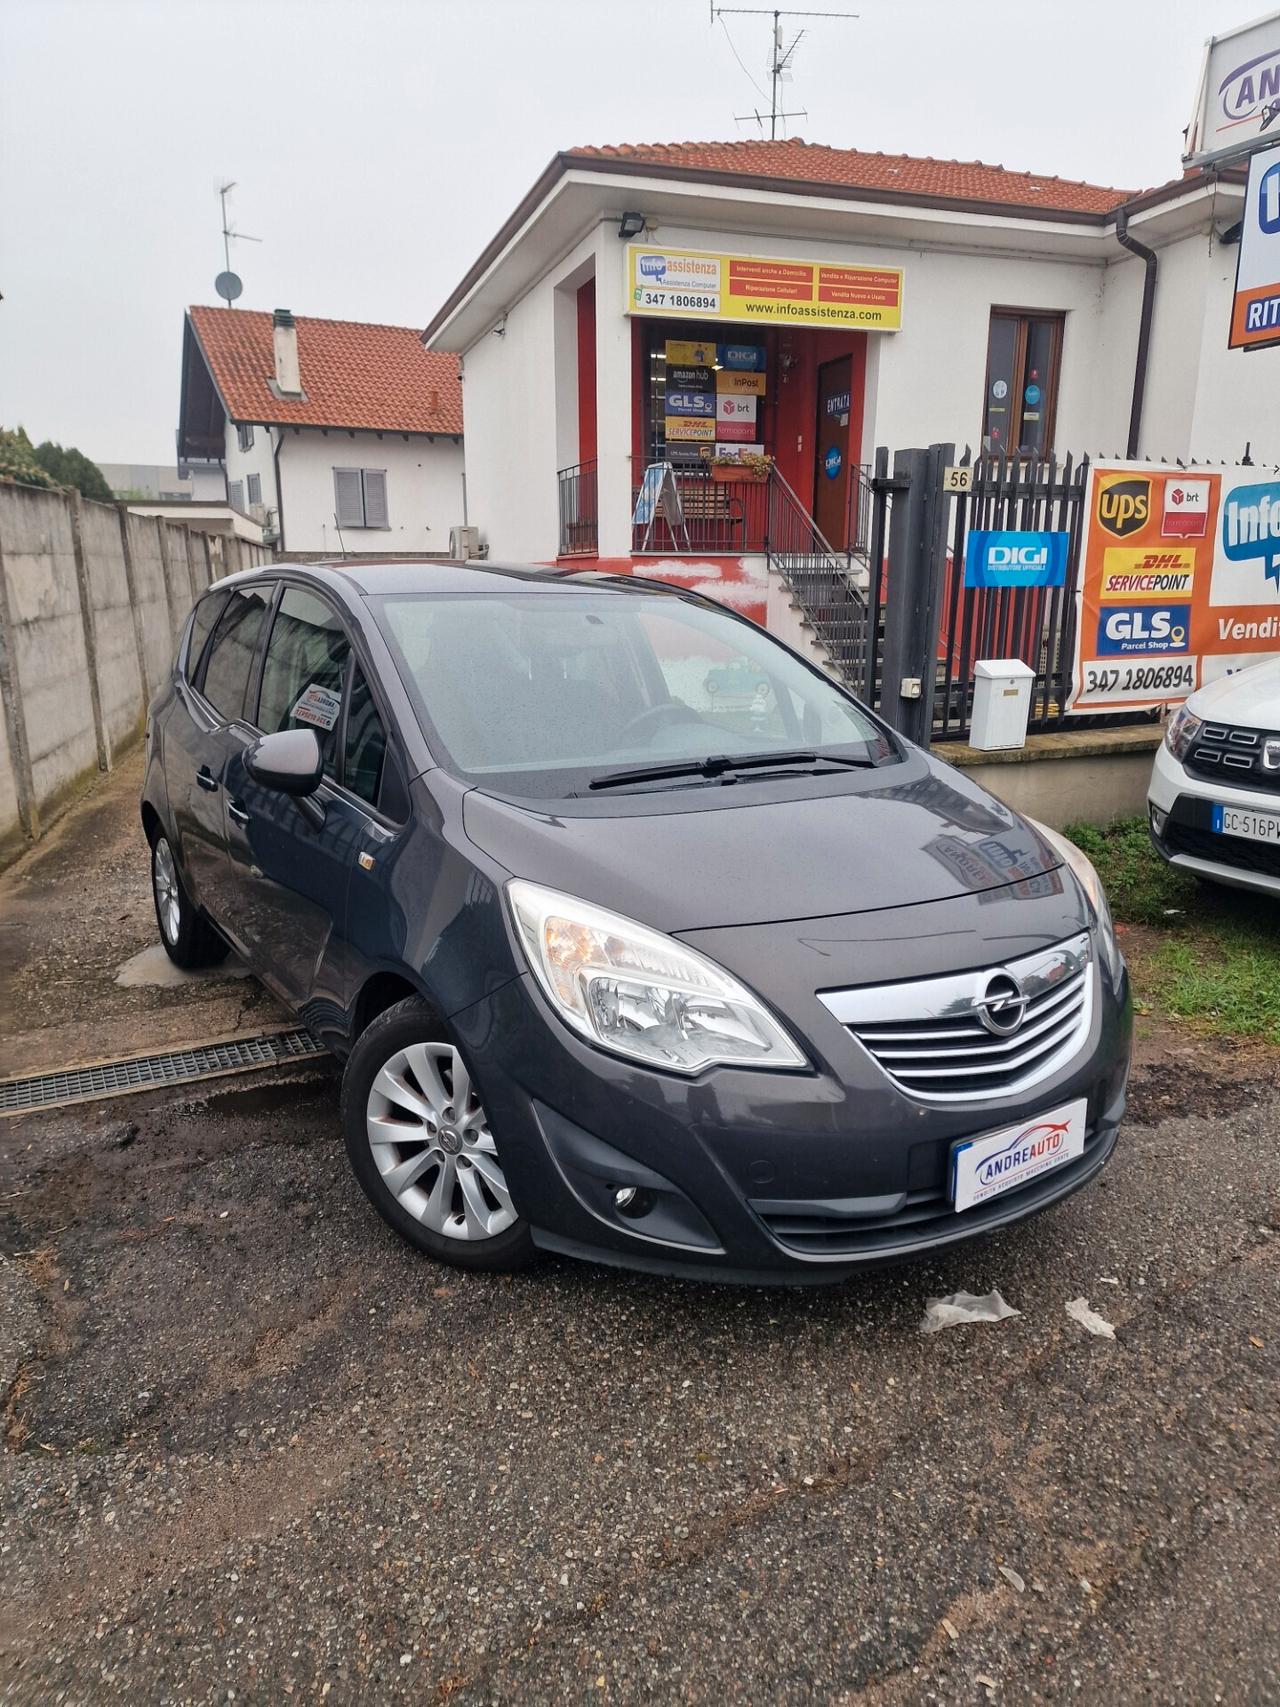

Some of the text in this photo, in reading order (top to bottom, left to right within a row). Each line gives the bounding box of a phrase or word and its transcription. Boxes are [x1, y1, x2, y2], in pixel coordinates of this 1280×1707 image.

[667, 259, 717, 275] assistenza
[662, 279, 717, 289] Assistenza Computer
[821, 271, 839, 280] Vendita
[845, 273, 872, 282] Riparazione
[874, 276, 898, 284] Computer
[745, 284, 775, 292] Riparazione
[831, 290, 849, 298] Vendita
[645, 292, 716, 308] 347 1806894
[746, 302, 882, 321] www.infoassistenza.com
[727, 350, 757, 360] DIGI
[673, 369, 708, 380] amazon hub
[734, 377, 759, 387] InPost
[668, 394, 704, 408] GLS
[737, 403, 749, 413] brt
[827, 393, 850, 413] ENTRATA
[683, 420, 708, 428] DHL
[950, 471, 968, 487] 56
[1186, 492, 1199, 503] brt
[1102, 493, 1148, 529] ups
[988, 547, 1048, 564] DIGI
[1142, 554, 1183, 569] DHL
[1105, 573, 1190, 592] SERVICEPOINT
[1105, 611, 1172, 640] GLS
[1218, 616, 1280, 640] Vendi
[1121, 640, 1168, 651] Parcel Shop
[1087, 665, 1194, 692] 347 1806894
[985, 1133, 1060, 1180] ANDREAUTO
